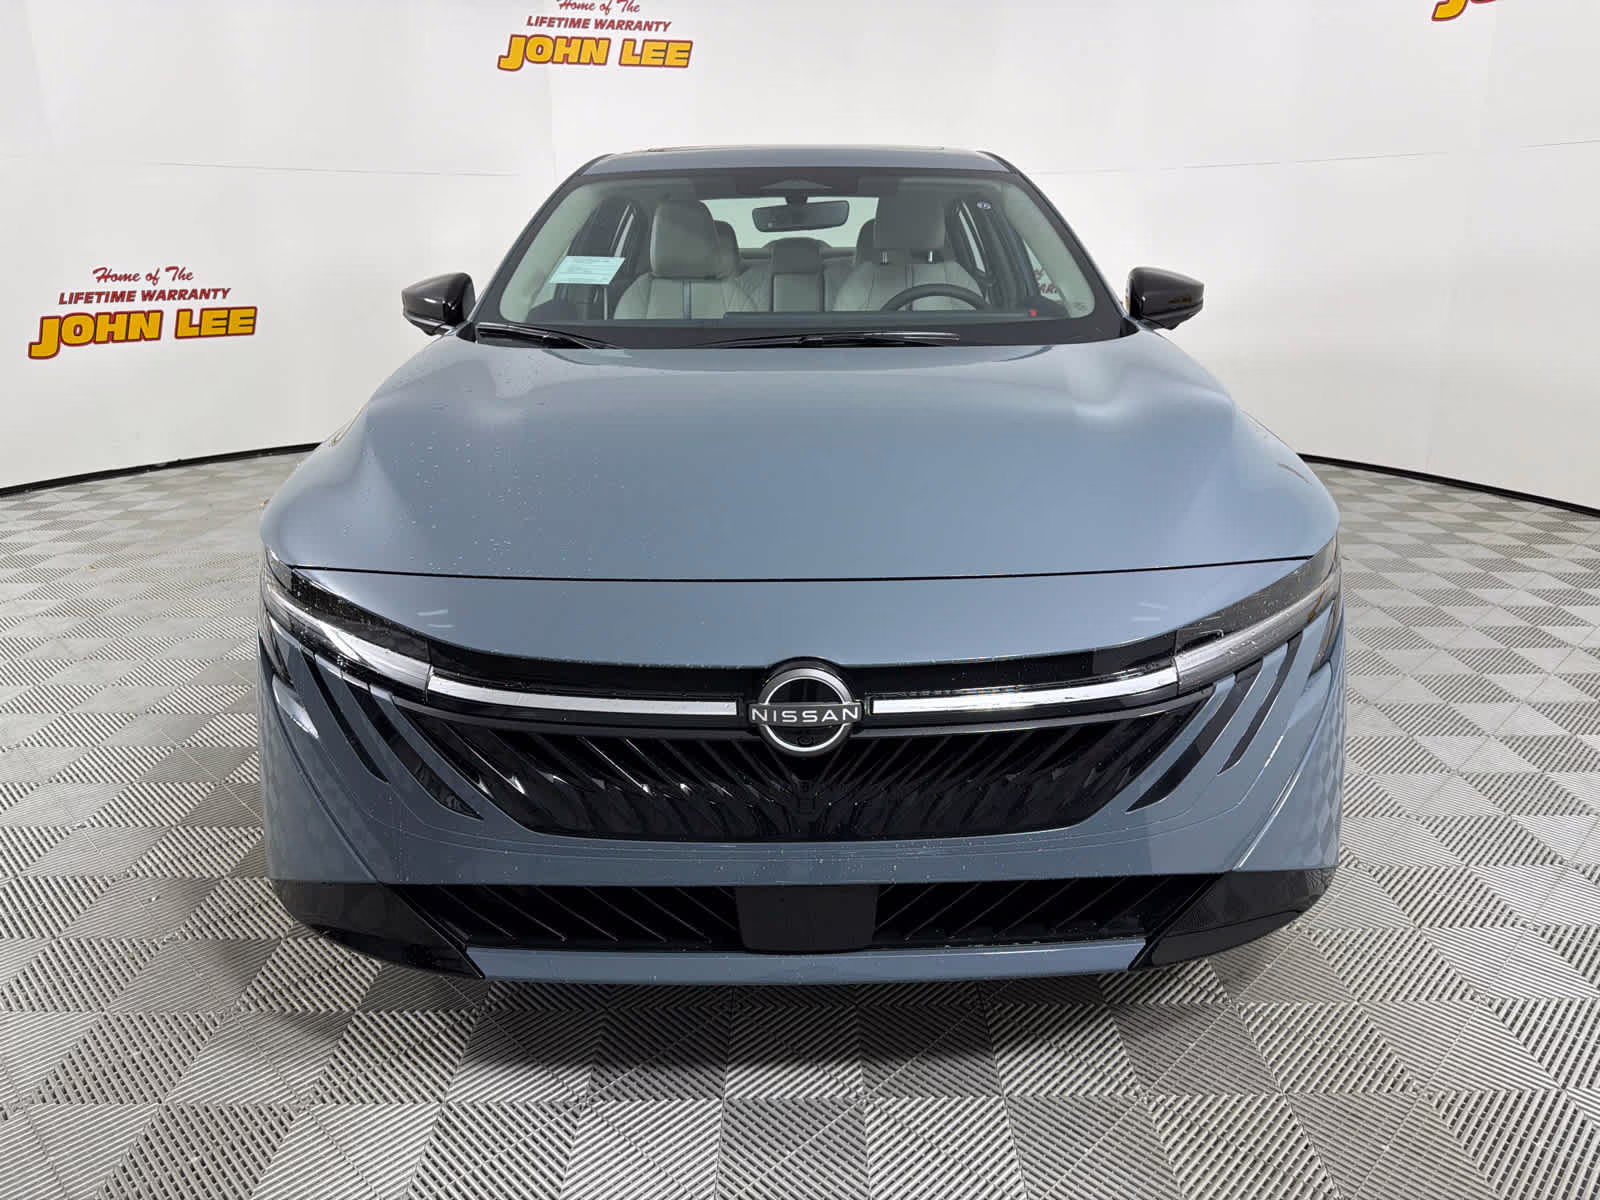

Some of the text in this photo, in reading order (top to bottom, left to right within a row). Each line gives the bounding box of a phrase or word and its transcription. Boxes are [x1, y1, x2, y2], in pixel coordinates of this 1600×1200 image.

[555, 0, 641, 15] Home of The
[526, 15, 672, 33] LIFETIME WARRANTY
[497, 34, 693, 72] JOHN LEE
[92, 266, 194, 286] Home of The
[58, 287, 232, 305] LIFETIME WARRANTY
[28, 306, 258, 360] JOHN LEE
[751, 706, 859, 723] NISSAN
